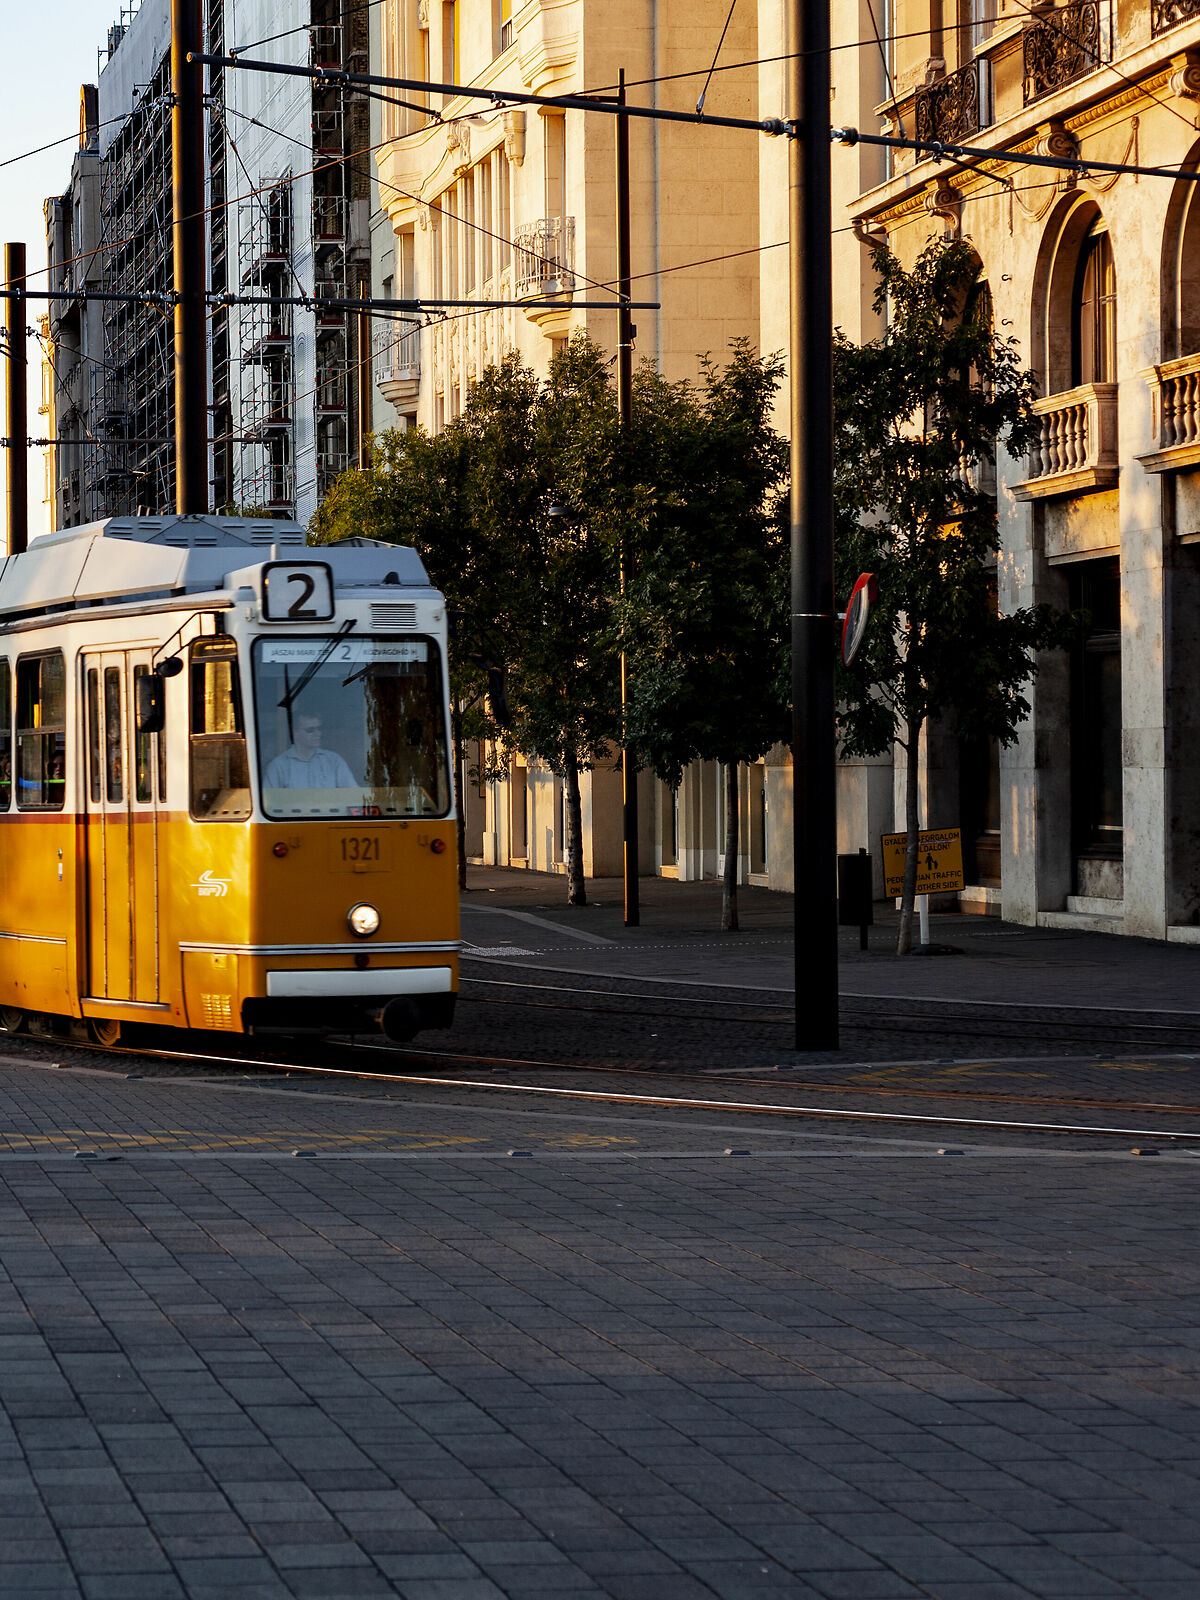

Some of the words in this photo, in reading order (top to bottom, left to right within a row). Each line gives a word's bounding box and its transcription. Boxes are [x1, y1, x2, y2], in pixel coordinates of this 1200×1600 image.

[287, 573, 317, 617] 2
[341, 645, 352, 660] 2
[341, 838, 379, 860] 1321
[886, 873, 931, 885] PEDEIAN
[932, 870, 962, 880] TRAFFIC
[890, 887, 901, 895] ON
[917, 882, 941, 892] OTHER
[943, 880, 960, 889] SIDE
